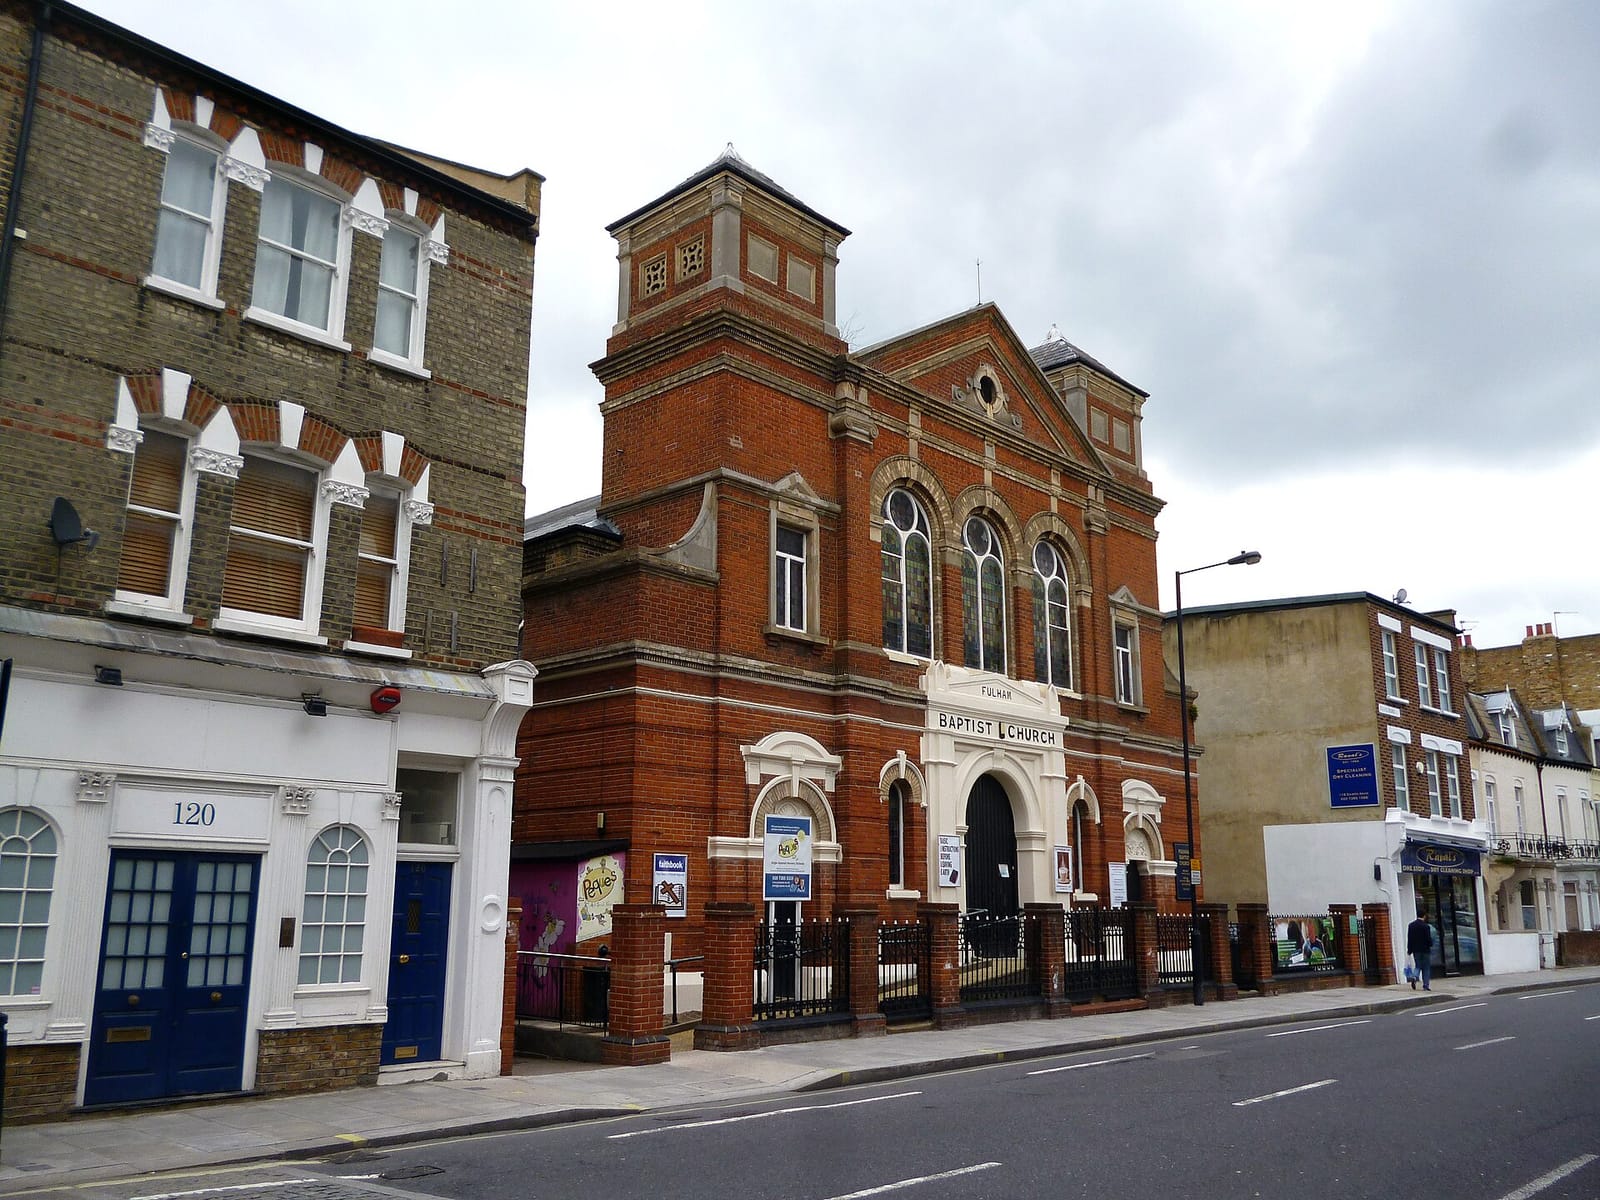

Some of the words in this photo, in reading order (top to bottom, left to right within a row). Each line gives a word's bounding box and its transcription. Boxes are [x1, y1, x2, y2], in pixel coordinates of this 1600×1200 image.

[981, 686, 1012, 700] FULHAM
[939, 713, 992, 735] BAPTIST
[1008, 725, 1055, 745] CHURCH
[172, 802, 216, 826] 120
[583, 870, 617, 900] Peques
